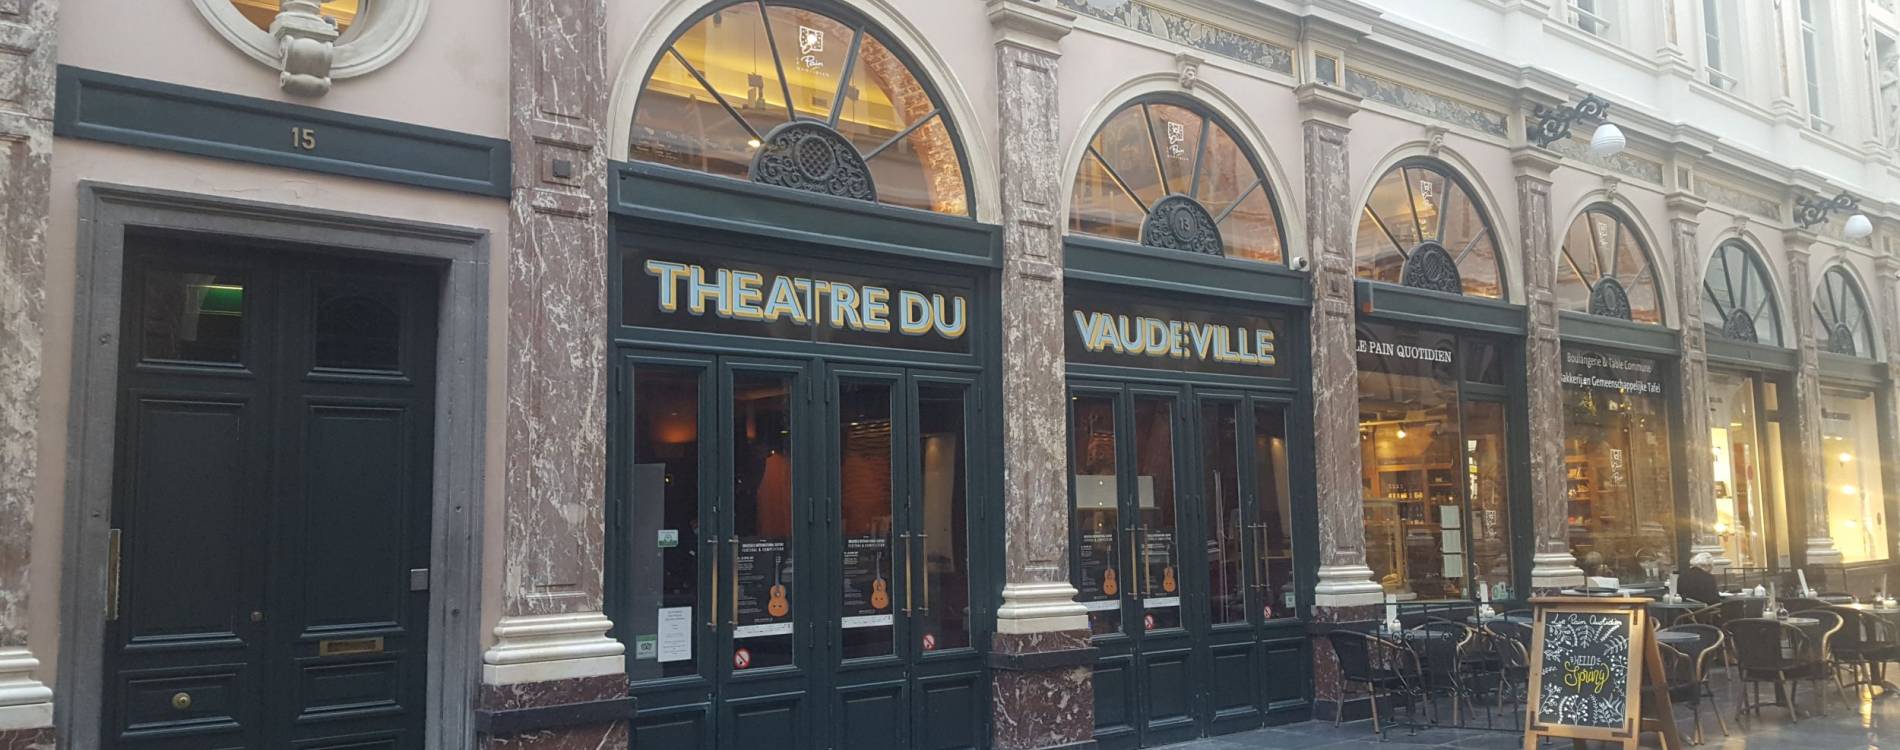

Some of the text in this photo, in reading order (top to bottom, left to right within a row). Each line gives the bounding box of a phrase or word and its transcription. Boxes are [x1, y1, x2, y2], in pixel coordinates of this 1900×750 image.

[292, 127, 316, 149] 15
[645, 259, 966, 338] THEATRE DU
[1072, 310, 1275, 366] VAUDEVILLE
[1369, 341, 1394, 356] PAIN
[1396, 345, 1452, 362] QUOTIDIEN
[1609, 358, 1624, 369] Table
[1561, 372, 1583, 388] akkerij
[1592, 376, 1647, 394] Gemeenschappelijke
[1647, 382, 1661, 393] Tafel
[1568, 613, 1587, 625] Pain
[1573, 655, 1596, 666] HELLO
[1564, 661, 1610, 694] Spring
